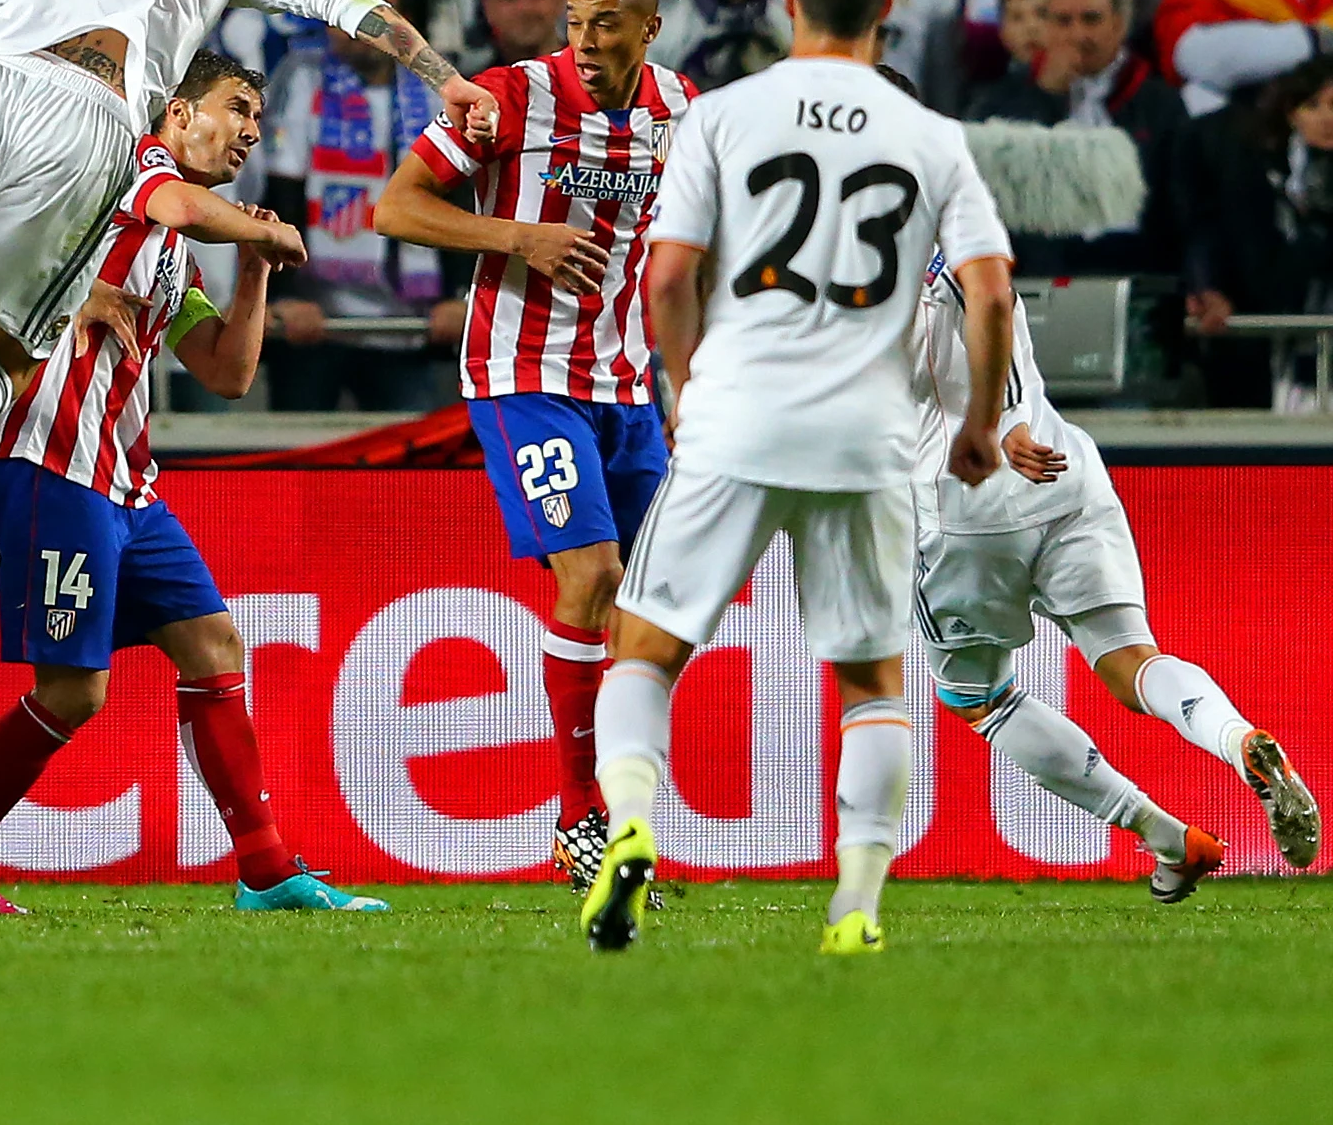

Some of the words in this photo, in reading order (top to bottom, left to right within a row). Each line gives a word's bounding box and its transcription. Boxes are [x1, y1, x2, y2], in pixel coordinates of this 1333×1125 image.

[796, 99, 868, 134] ISCO
[556, 162, 659, 200] AZERBAIJA
[561, 185, 595, 198] LAND
[598, 191, 614, 201] OF
[732, 152, 919, 309] 23
[516, 437, 580, 502] 23
[40, 549, 94, 610] 14
